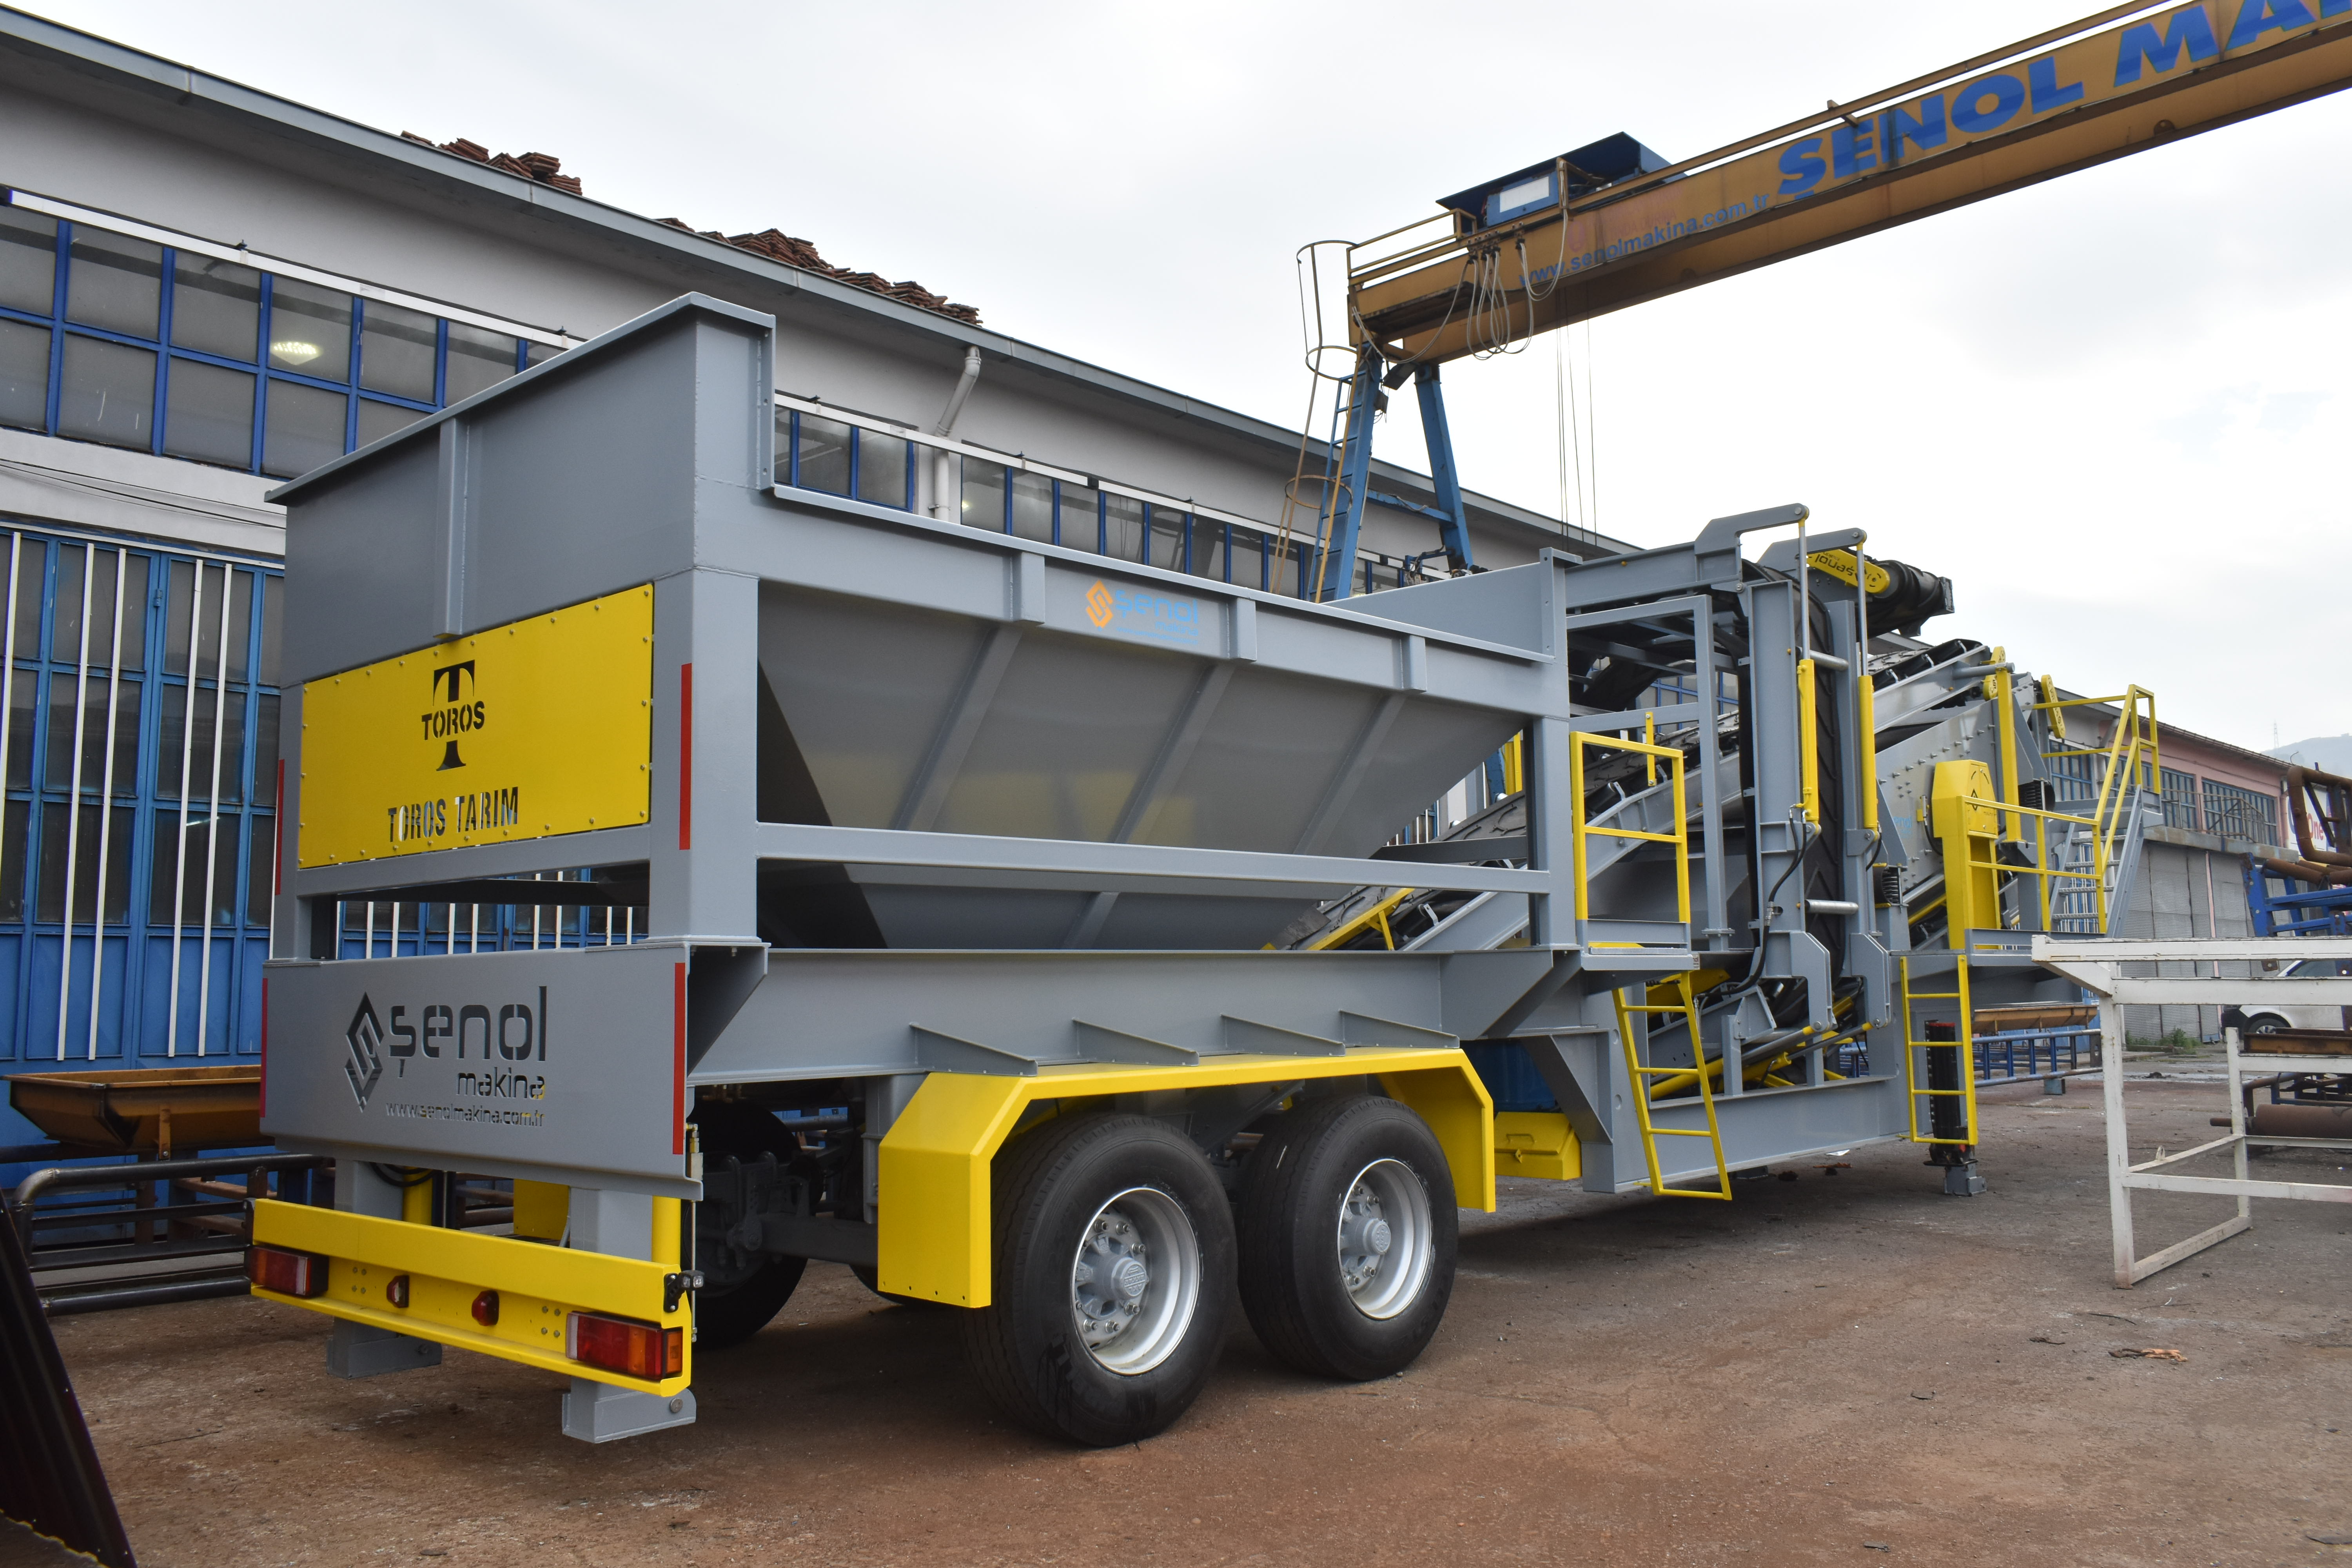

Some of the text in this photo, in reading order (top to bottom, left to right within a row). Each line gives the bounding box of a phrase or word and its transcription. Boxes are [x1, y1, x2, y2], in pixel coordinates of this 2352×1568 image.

[1519, 194, 1769, 287] www.senolmakina.com.tr
[1115, 590, 1198, 624] şenol
[421, 701, 485, 740] TOROS
[388, 786, 519, 842] TOROS TARIM
[388, 986, 547, 1078] şenol
[456, 1067, 545, 1099] makina
[386, 1102, 545, 1127] www.senolmakina.com.tr
